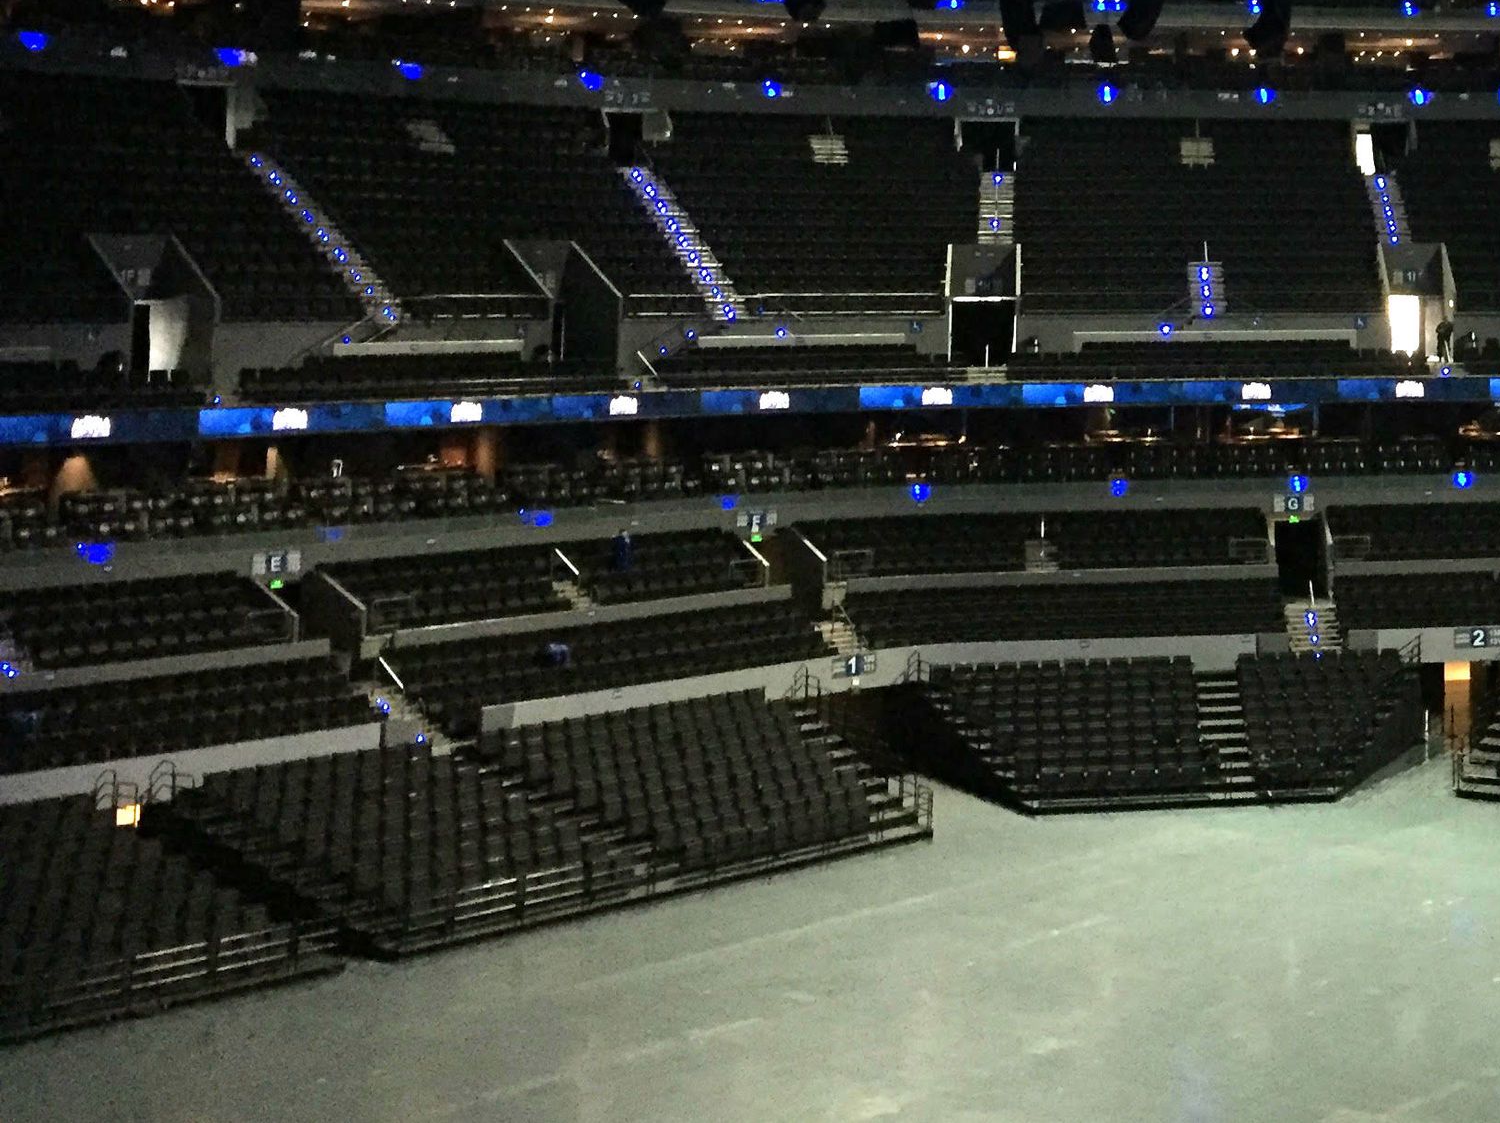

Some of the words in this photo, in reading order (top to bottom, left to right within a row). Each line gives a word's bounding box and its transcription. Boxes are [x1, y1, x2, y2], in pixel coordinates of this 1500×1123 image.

[1288, 497, 1299, 510] G
[270, 556, 282, 572] E
[1473, 629, 1485, 647] 2
[848, 656, 856, 674] 1
